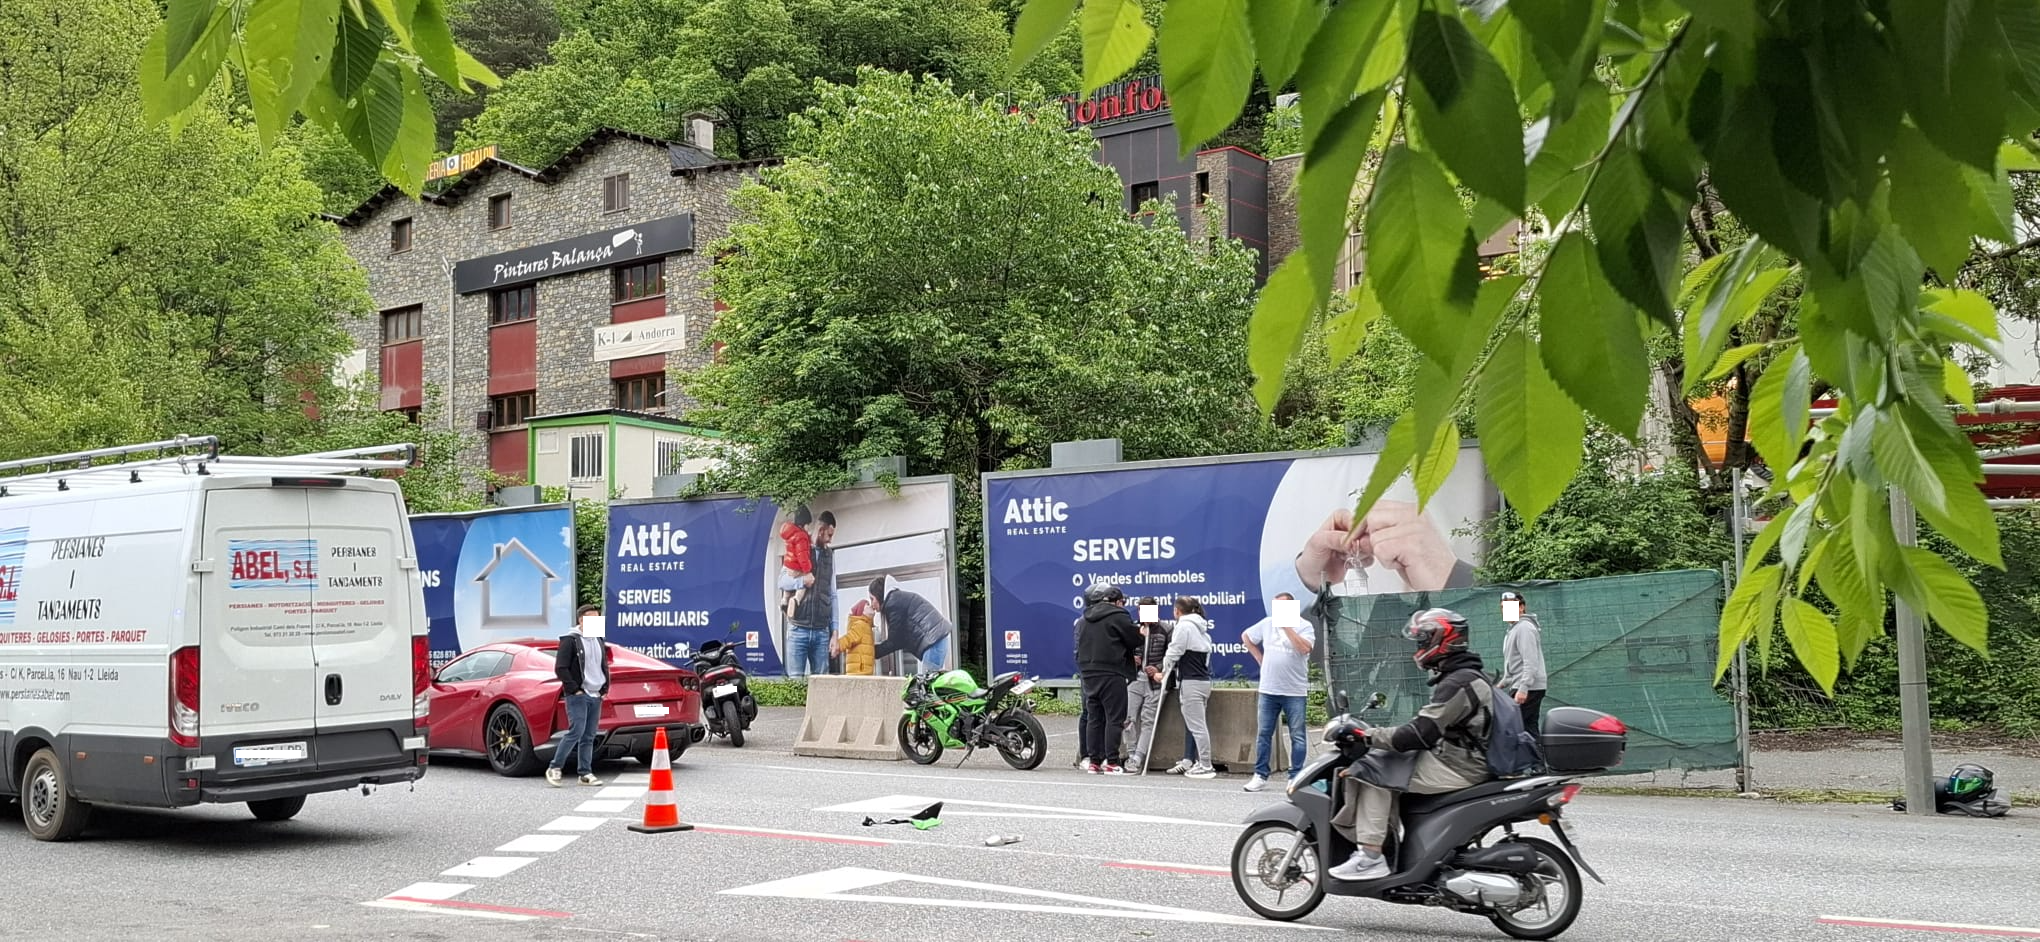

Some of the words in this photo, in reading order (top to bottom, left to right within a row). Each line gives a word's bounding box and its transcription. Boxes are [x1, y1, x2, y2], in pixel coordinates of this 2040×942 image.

[1059, 80, 1172, 124] onfo
[493, 257, 549, 283] Pintures
[552, 244, 614, 269] Balança
[639, 325, 676, 341] Andorra
[1003, 495, 1069, 524] Attic
[617, 521, 688, 557] Attic
[1007, 528, 1030, 536] REAL
[1033, 526, 1067, 535] ESTATE
[51, 536, 105, 560] PERSIANES
[1073, 536, 1176, 562] SERVEIS
[232, 550, 290, 583] ABEL,
[620, 563, 645, 573] REAL
[648, 561, 685, 572] ESTATE
[1088, 572, 1132, 585] Vendes
[1134, 569, 1206, 585] d'immobles
[618, 588, 672, 605] SERVEIS
[1174, 591, 1246, 606] iobiliari
[38, 598, 102, 621] TANCAMENTS
[617, 610, 709, 627] IMMOBILIARIS
[37, 631, 70, 644] GELOSIES
[76, 630, 105, 643] PORTES
[111, 630, 147, 643] PARQUET
[1210, 641, 1250, 657] nques
[58, 668, 65, 680] 16
[69, 668, 81, 680] Nau
[98, 668, 119, 680] Lleida
[380, 693, 402, 702] DAILY
[220, 702, 260, 713] IVECO
